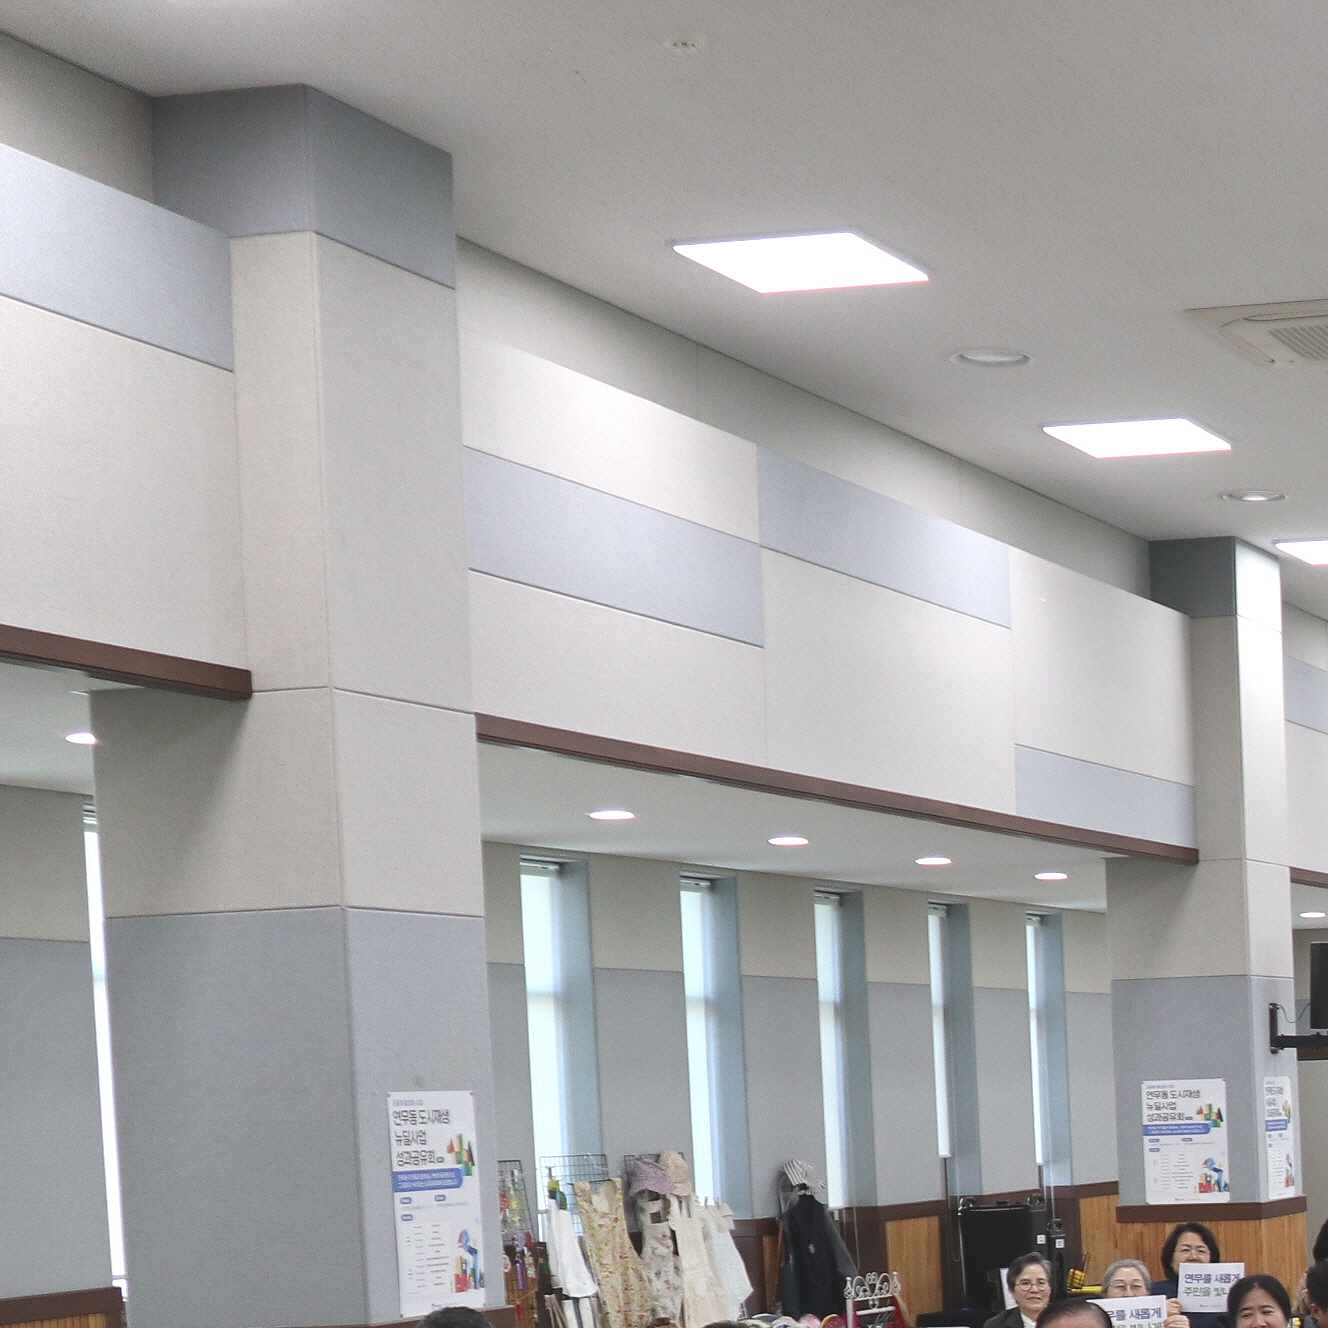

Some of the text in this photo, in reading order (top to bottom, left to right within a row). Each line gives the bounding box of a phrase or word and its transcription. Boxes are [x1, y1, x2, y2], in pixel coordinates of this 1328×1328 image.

[1146, 1089, 1200, 1100] 연무동 도시재생
[1146, 1101, 1177, 1111] 뉴딜사업
[392, 1109, 450, 1125] 연무동 도시재생
[1146, 1112, 1185, 1122] 성과공유회
[393, 1129, 427, 1146] 뉴딜사업
[396, 1150, 436, 1168] 성과공유회
[1184, 1273, 1212, 1284] 연무를
[1129, 1307, 1162, 1320] 새롭게
